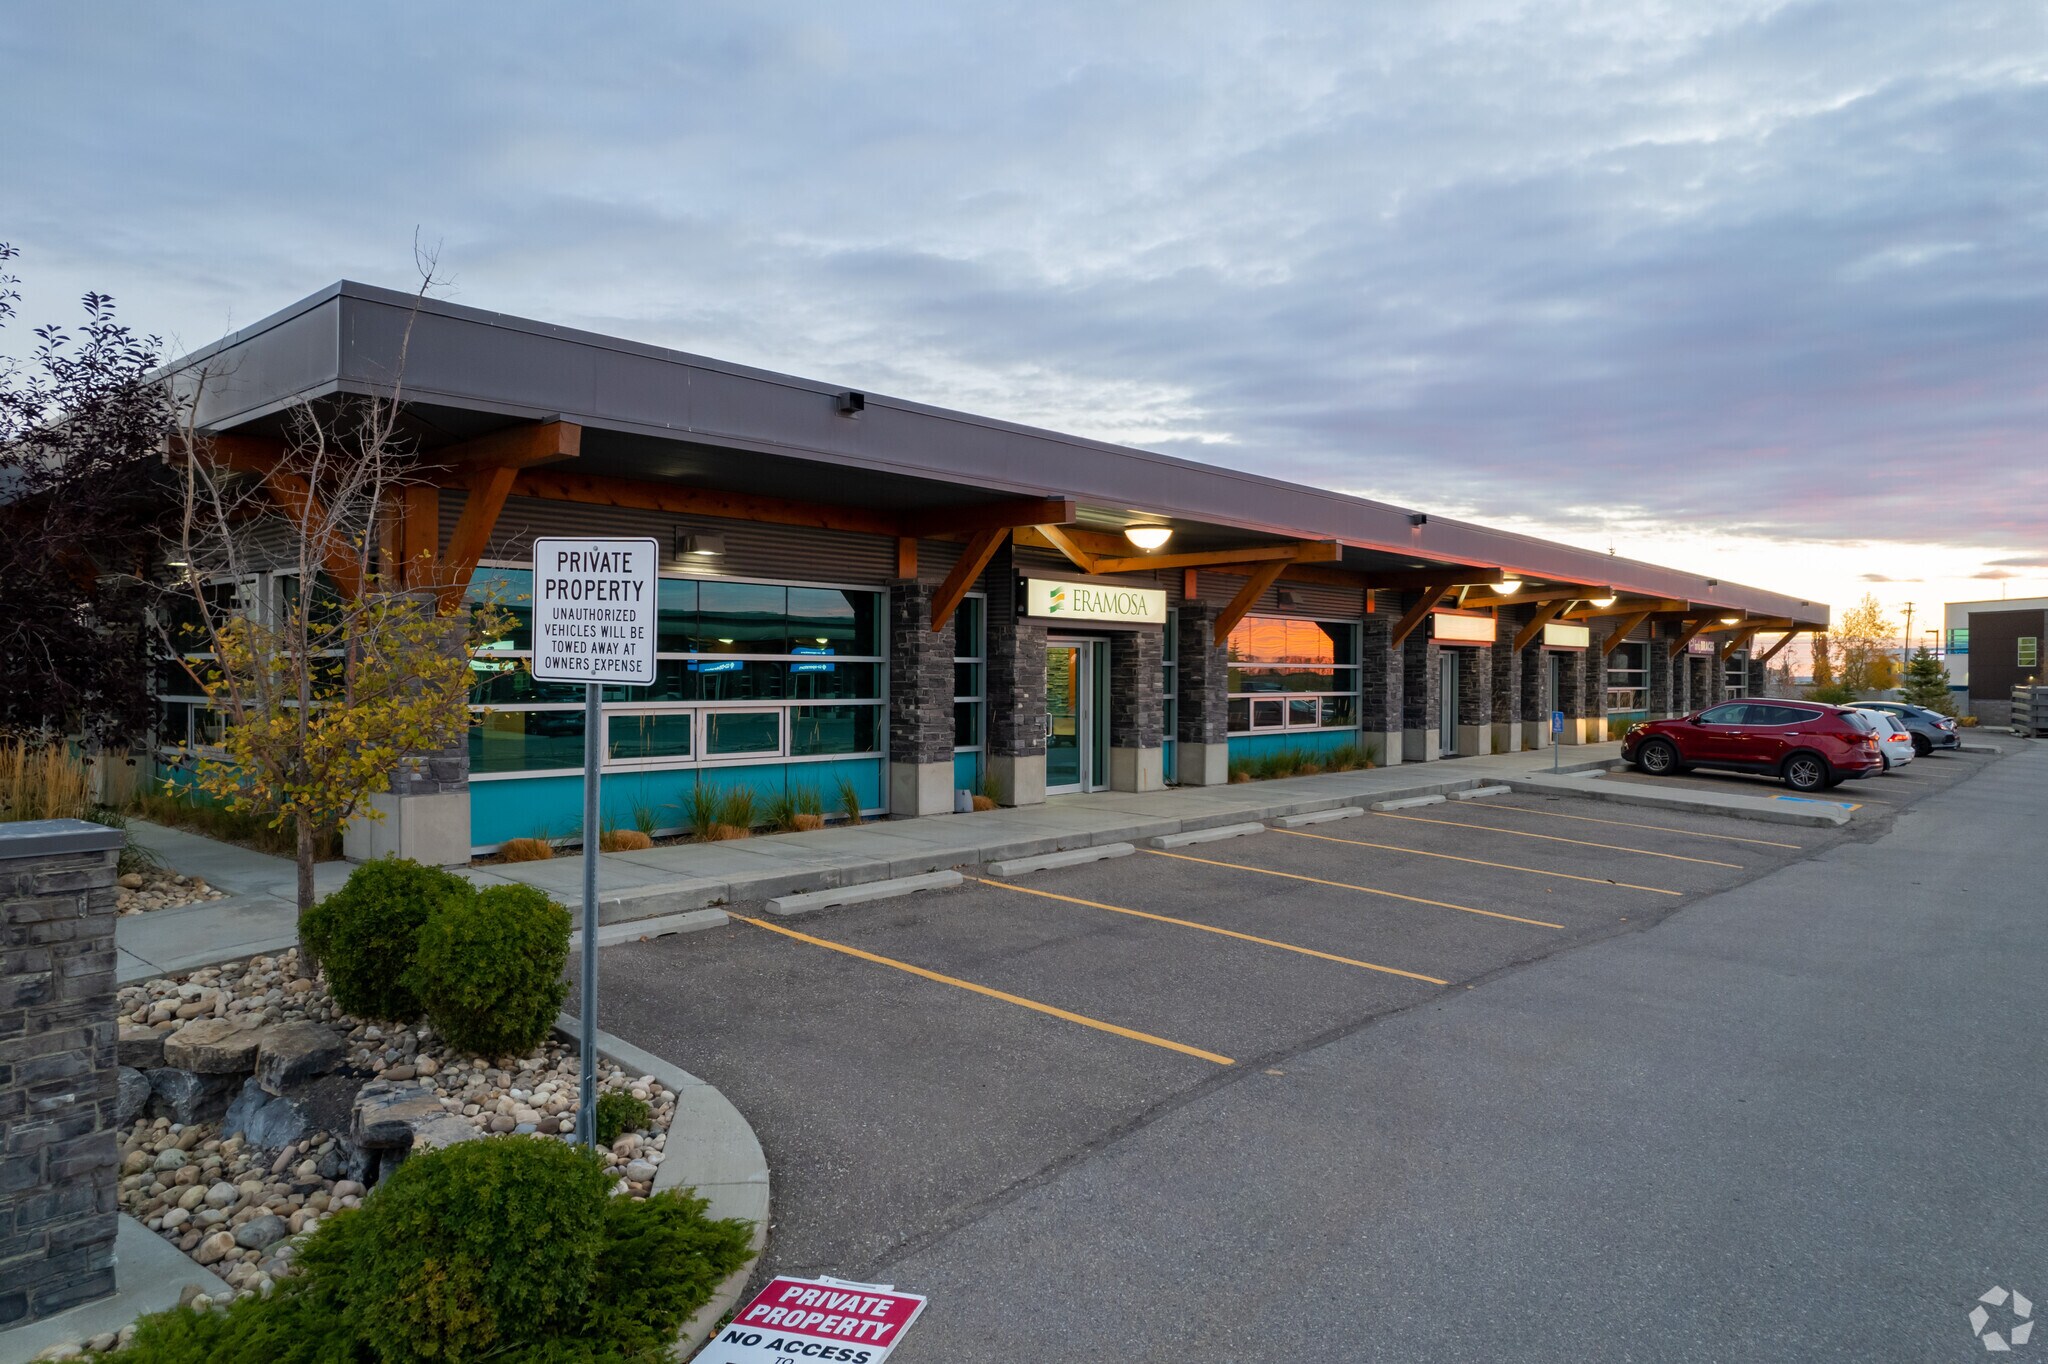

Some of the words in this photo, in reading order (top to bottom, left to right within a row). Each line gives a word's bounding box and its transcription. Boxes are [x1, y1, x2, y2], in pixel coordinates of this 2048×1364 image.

[558, 552, 632, 573] PRIVATE
[546, 579, 644, 601] PROPERTY
[1073, 589, 1148, 616] ERAMOSA
[553, 608, 636, 622] UNAUTHORIZED
[545, 624, 596, 638] VEHICLES
[601, 626, 626, 639] WILL
[631, 627, 644, 639] BE
[552, 641, 587, 654] TOWED
[591, 642, 619, 655] AWAY
[624, 643, 636, 655] AT
[545, 656, 590, 670] OWNERS
[594, 659, 642, 673] EXPENSE
[778, 1286, 895, 1317] PRIVATE
[744, 1304, 895, 1340] PROPERTY
[722, 1330, 763, 1346] NO
[764, 1338, 872, 1364] ACCESS
